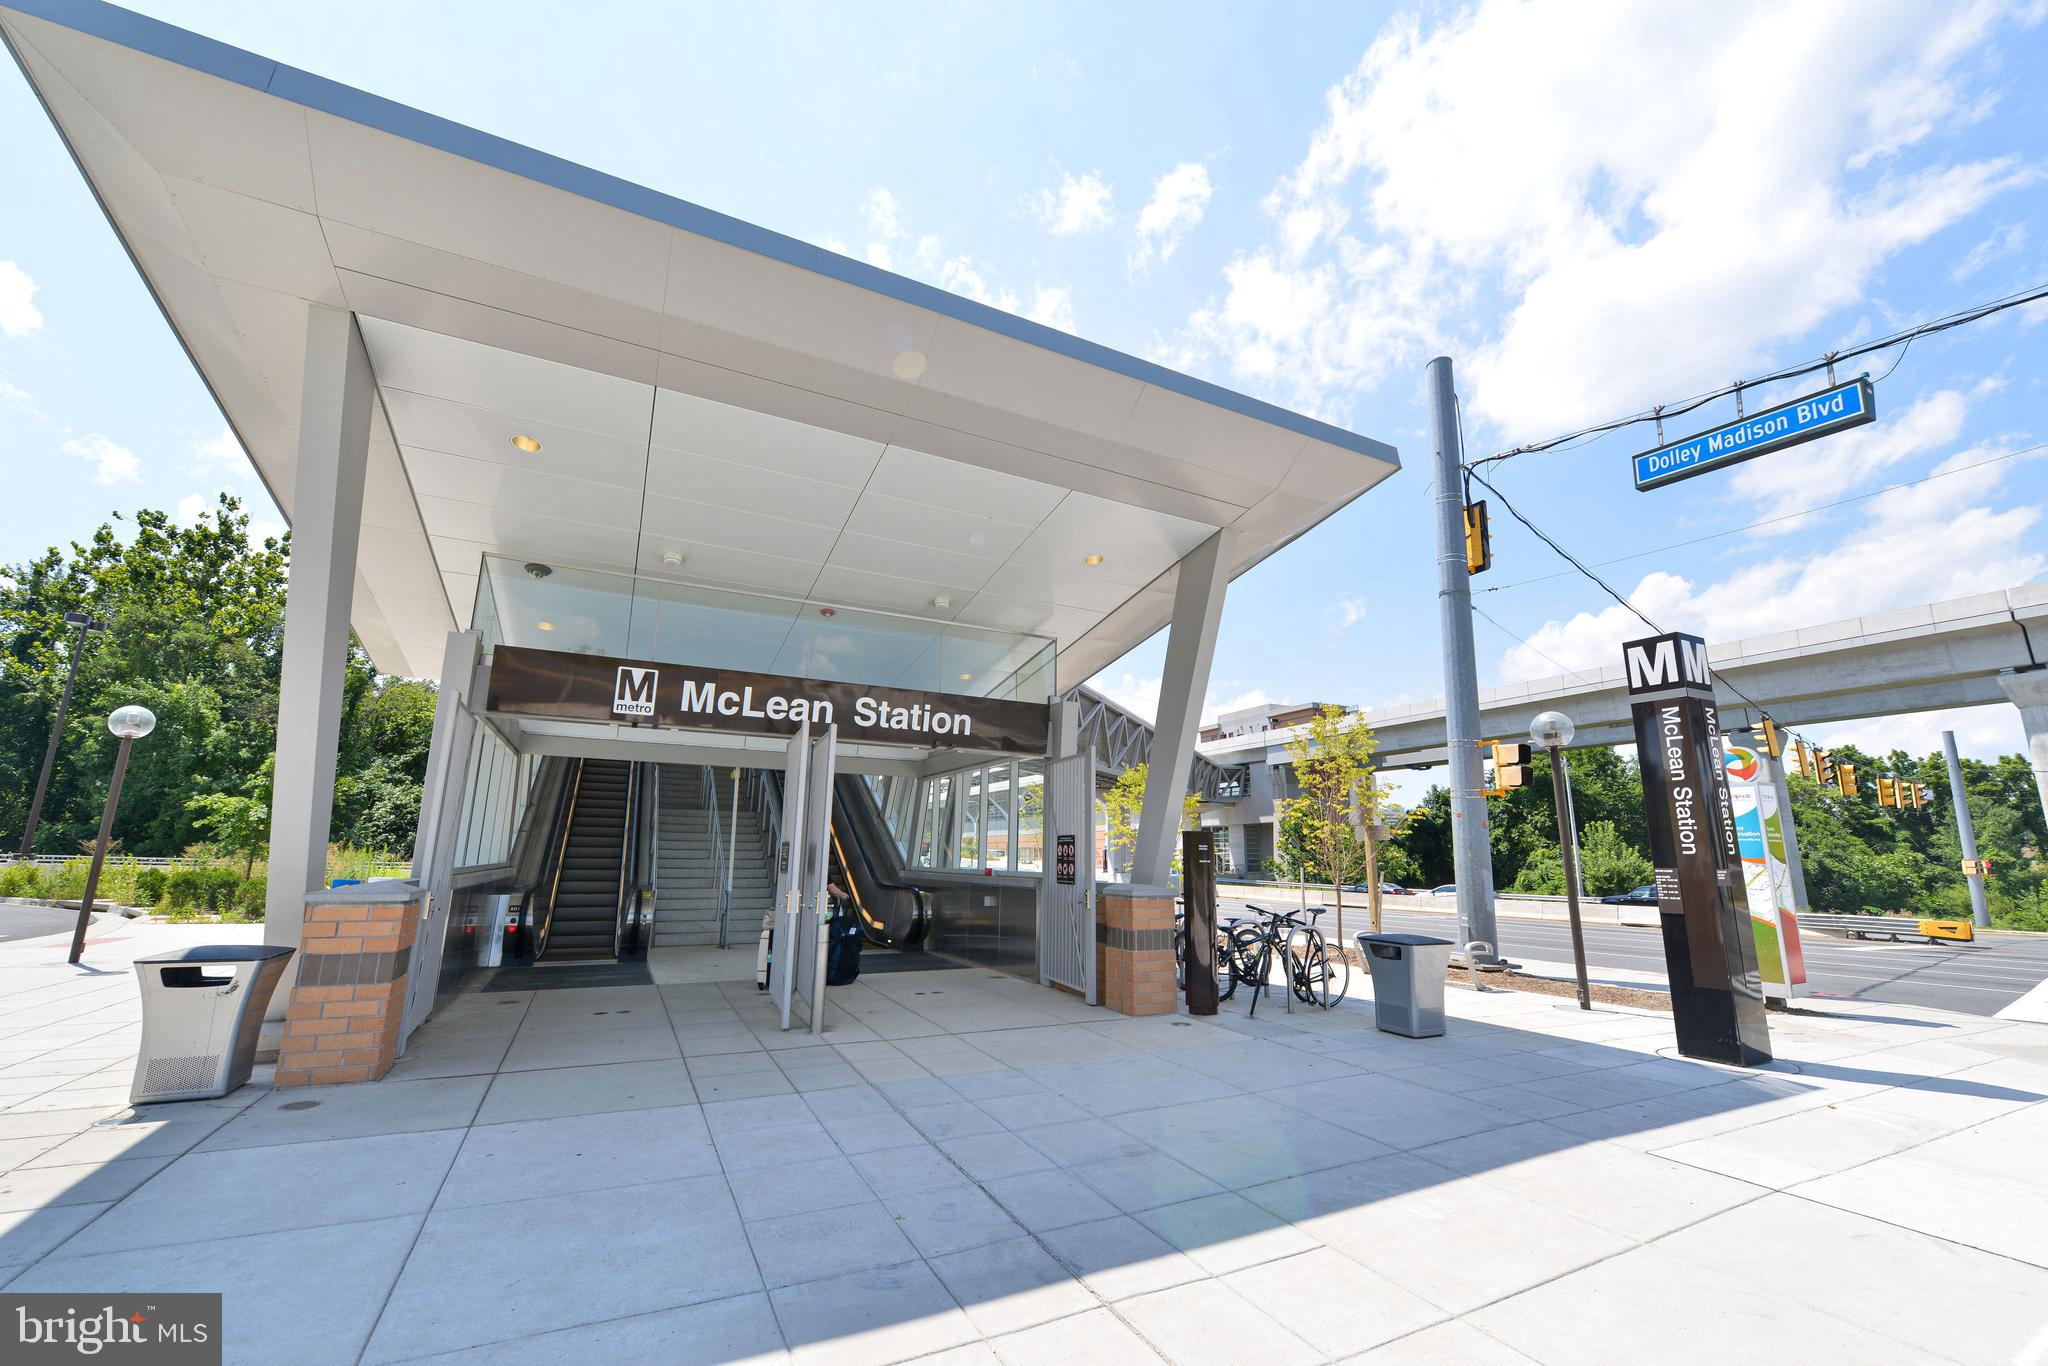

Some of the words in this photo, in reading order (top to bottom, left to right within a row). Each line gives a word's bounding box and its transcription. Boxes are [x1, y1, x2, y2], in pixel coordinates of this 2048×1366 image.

[1648, 444, 1701, 473] Dolley
[1708, 416, 1788, 454] Madison
[1797, 393, 1844, 425] Blvd
[617, 669, 655, 703] M
[1627, 640, 1679, 688] M
[1681, 639, 1711, 685] M
[616, 702, 652, 714] metro
[680, 680, 834, 723] McLean
[853, 697, 972, 736] Station
[1661, 706, 1685, 781] McLean
[1673, 787, 1697, 855] Station
[1704, 707, 1724, 781] McLean
[1719, 787, 1736, 855] Station
